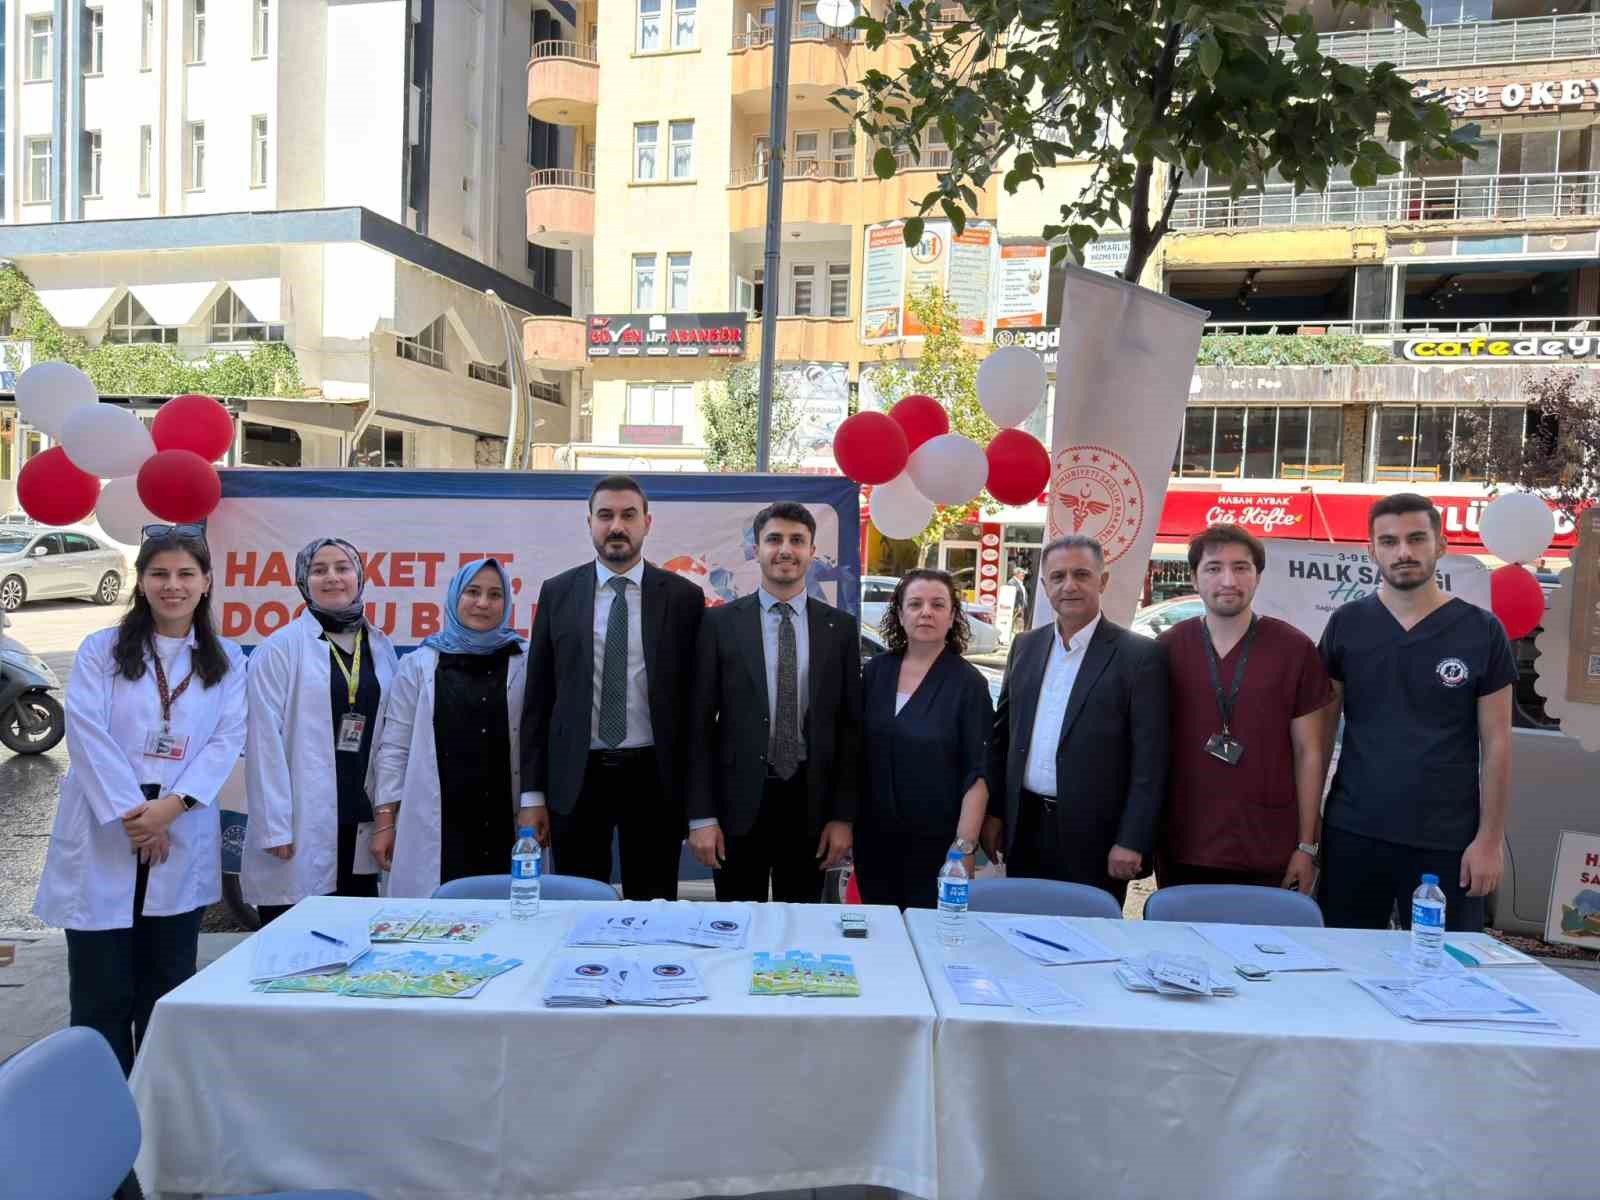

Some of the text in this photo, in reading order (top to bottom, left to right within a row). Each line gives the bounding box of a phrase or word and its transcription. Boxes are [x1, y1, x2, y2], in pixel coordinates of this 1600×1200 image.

[1238, 506, 1297, 532] Köfte
[225, 551, 445, 587] HAKET
[1289, 560, 1352, 583] HALK
[222, 601, 397, 637] DOU
